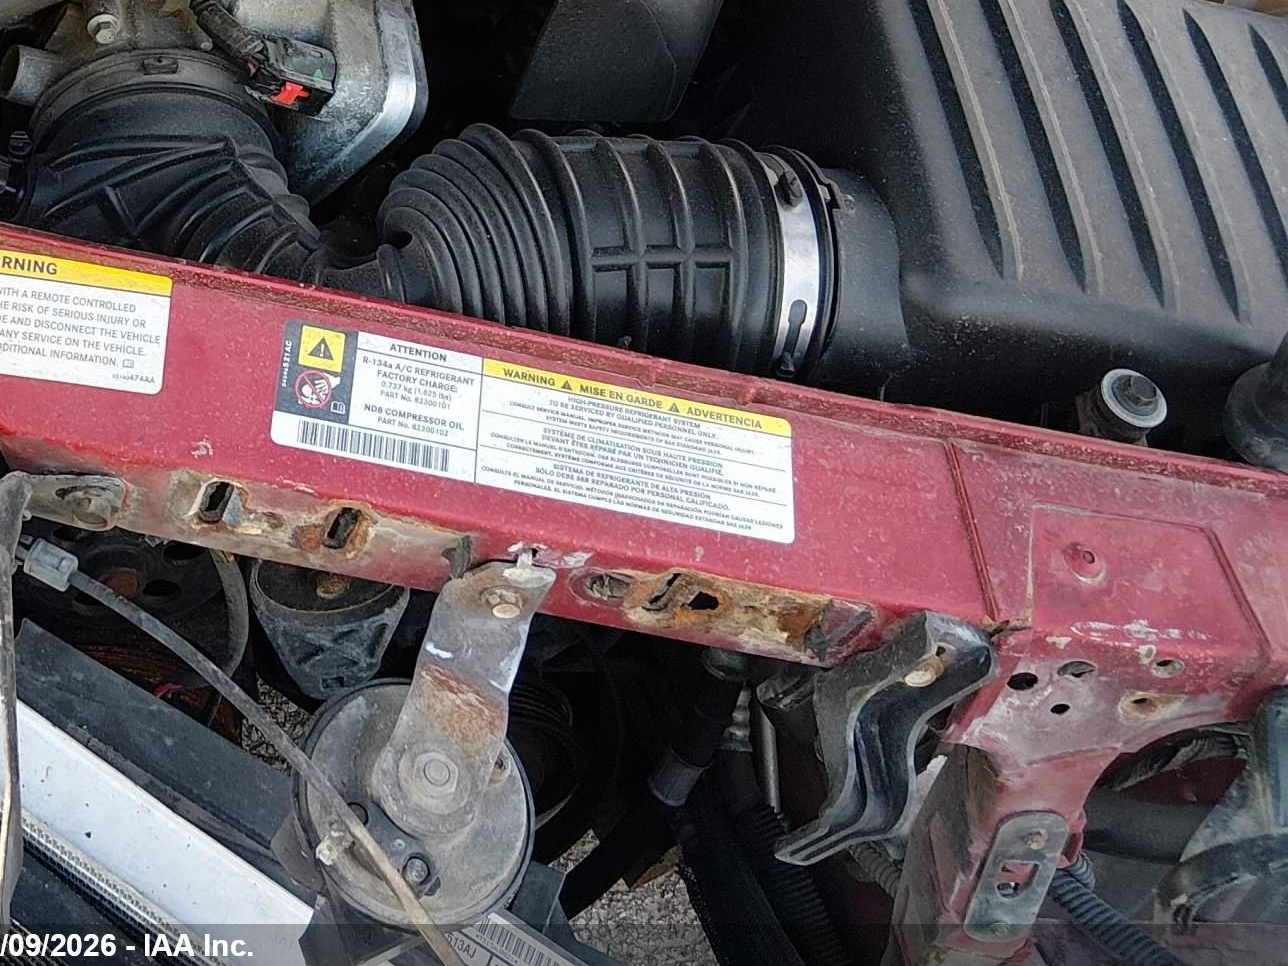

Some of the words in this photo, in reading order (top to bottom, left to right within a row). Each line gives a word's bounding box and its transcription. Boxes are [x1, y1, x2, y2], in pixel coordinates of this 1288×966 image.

[21, 288, 28, 299] A
[30, 289, 70, 304] REMOTE
[72, 295, 136, 314] CONTROLLED
[11, 301, 33, 313] RISK
[36, 304, 49, 315] OF
[51, 306, 94, 321] SERIOUS
[96, 313, 129, 326] INJURY
[131, 318, 146, 329] OR
[0, 326, 19, 338] ANY
[21, 330, 62, 344] SERVICE
[64, 336, 79, 347] ON
[82, 339, 100, 350] THE
[10, 314, 32, 326] AND
[33, 318, 95, 335] DISCONNECT
[99, 327, 117, 339] THE
[120, 330, 160, 345] VEHICLE
[49, 348, 120, 367] INFORMATION.
[403, 385, 412, 394] kg
